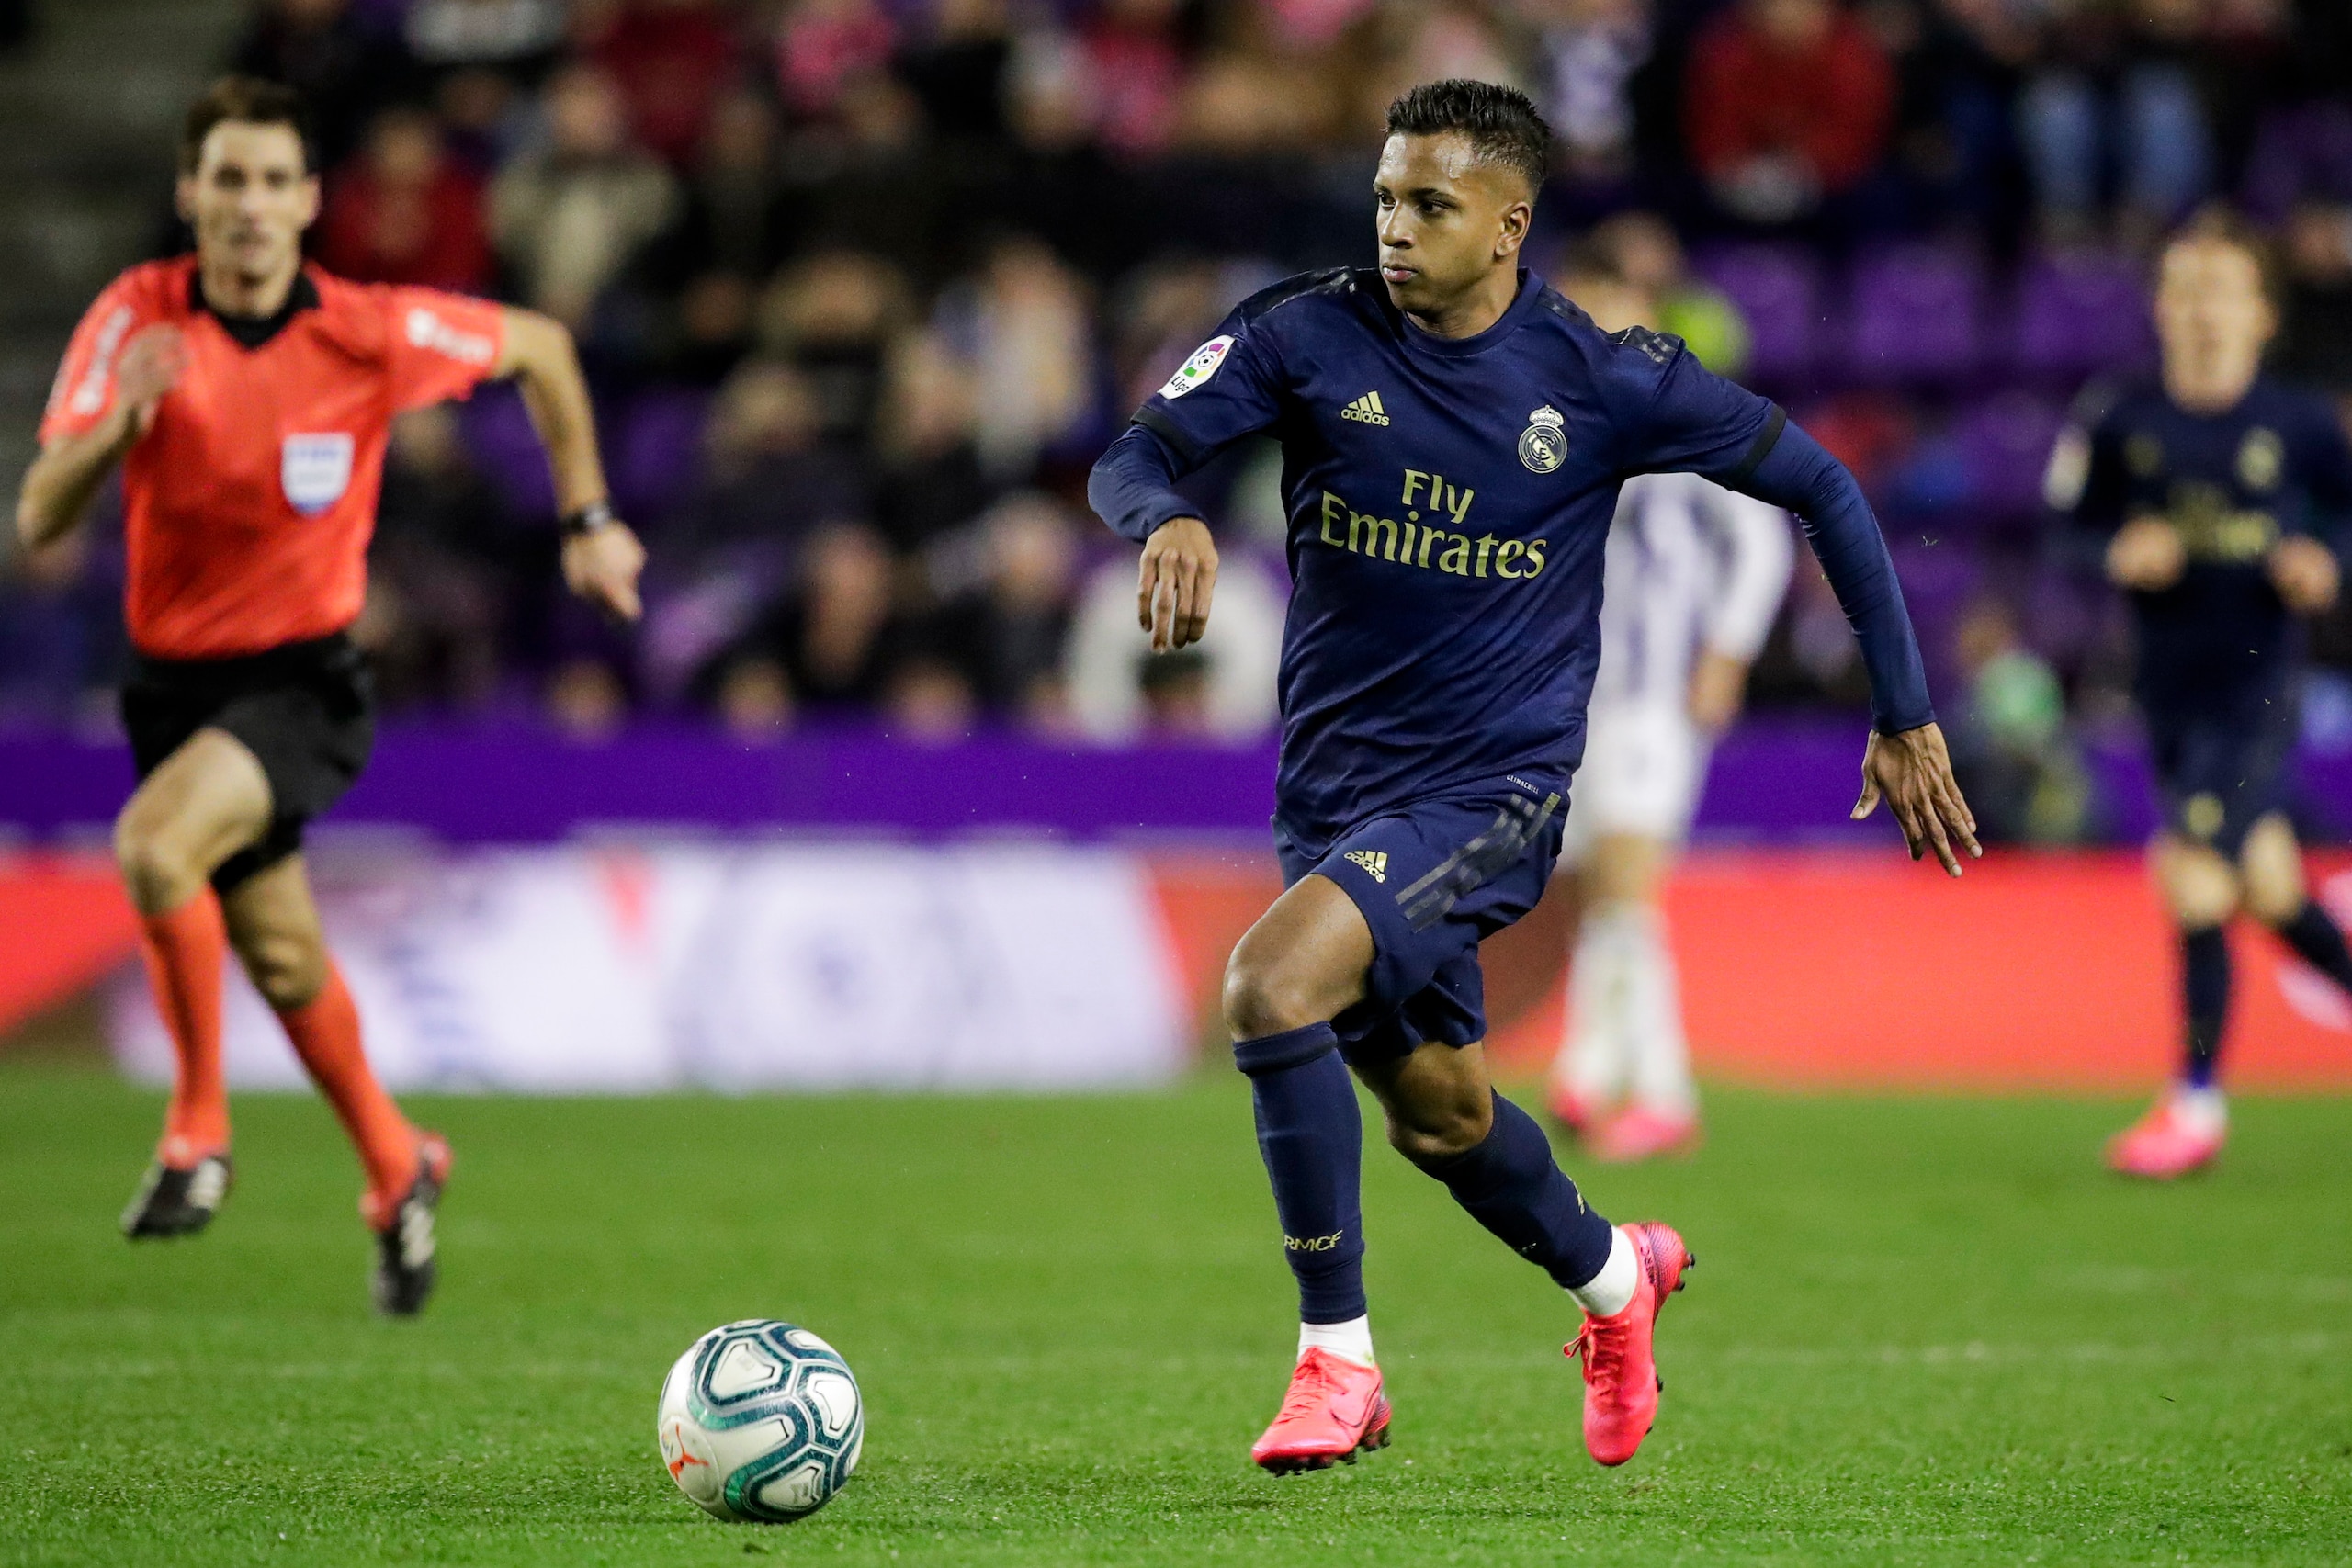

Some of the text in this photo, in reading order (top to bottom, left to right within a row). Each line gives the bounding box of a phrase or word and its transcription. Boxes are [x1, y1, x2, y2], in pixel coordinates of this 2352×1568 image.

[1340, 408, 1390, 426] adidas
[1402, 468, 1475, 524] Fly
[1320, 490, 1547, 579] Emirates
[1343, 852, 1386, 884] adidas
[1283, 1229, 1343, 1251] RMCF
